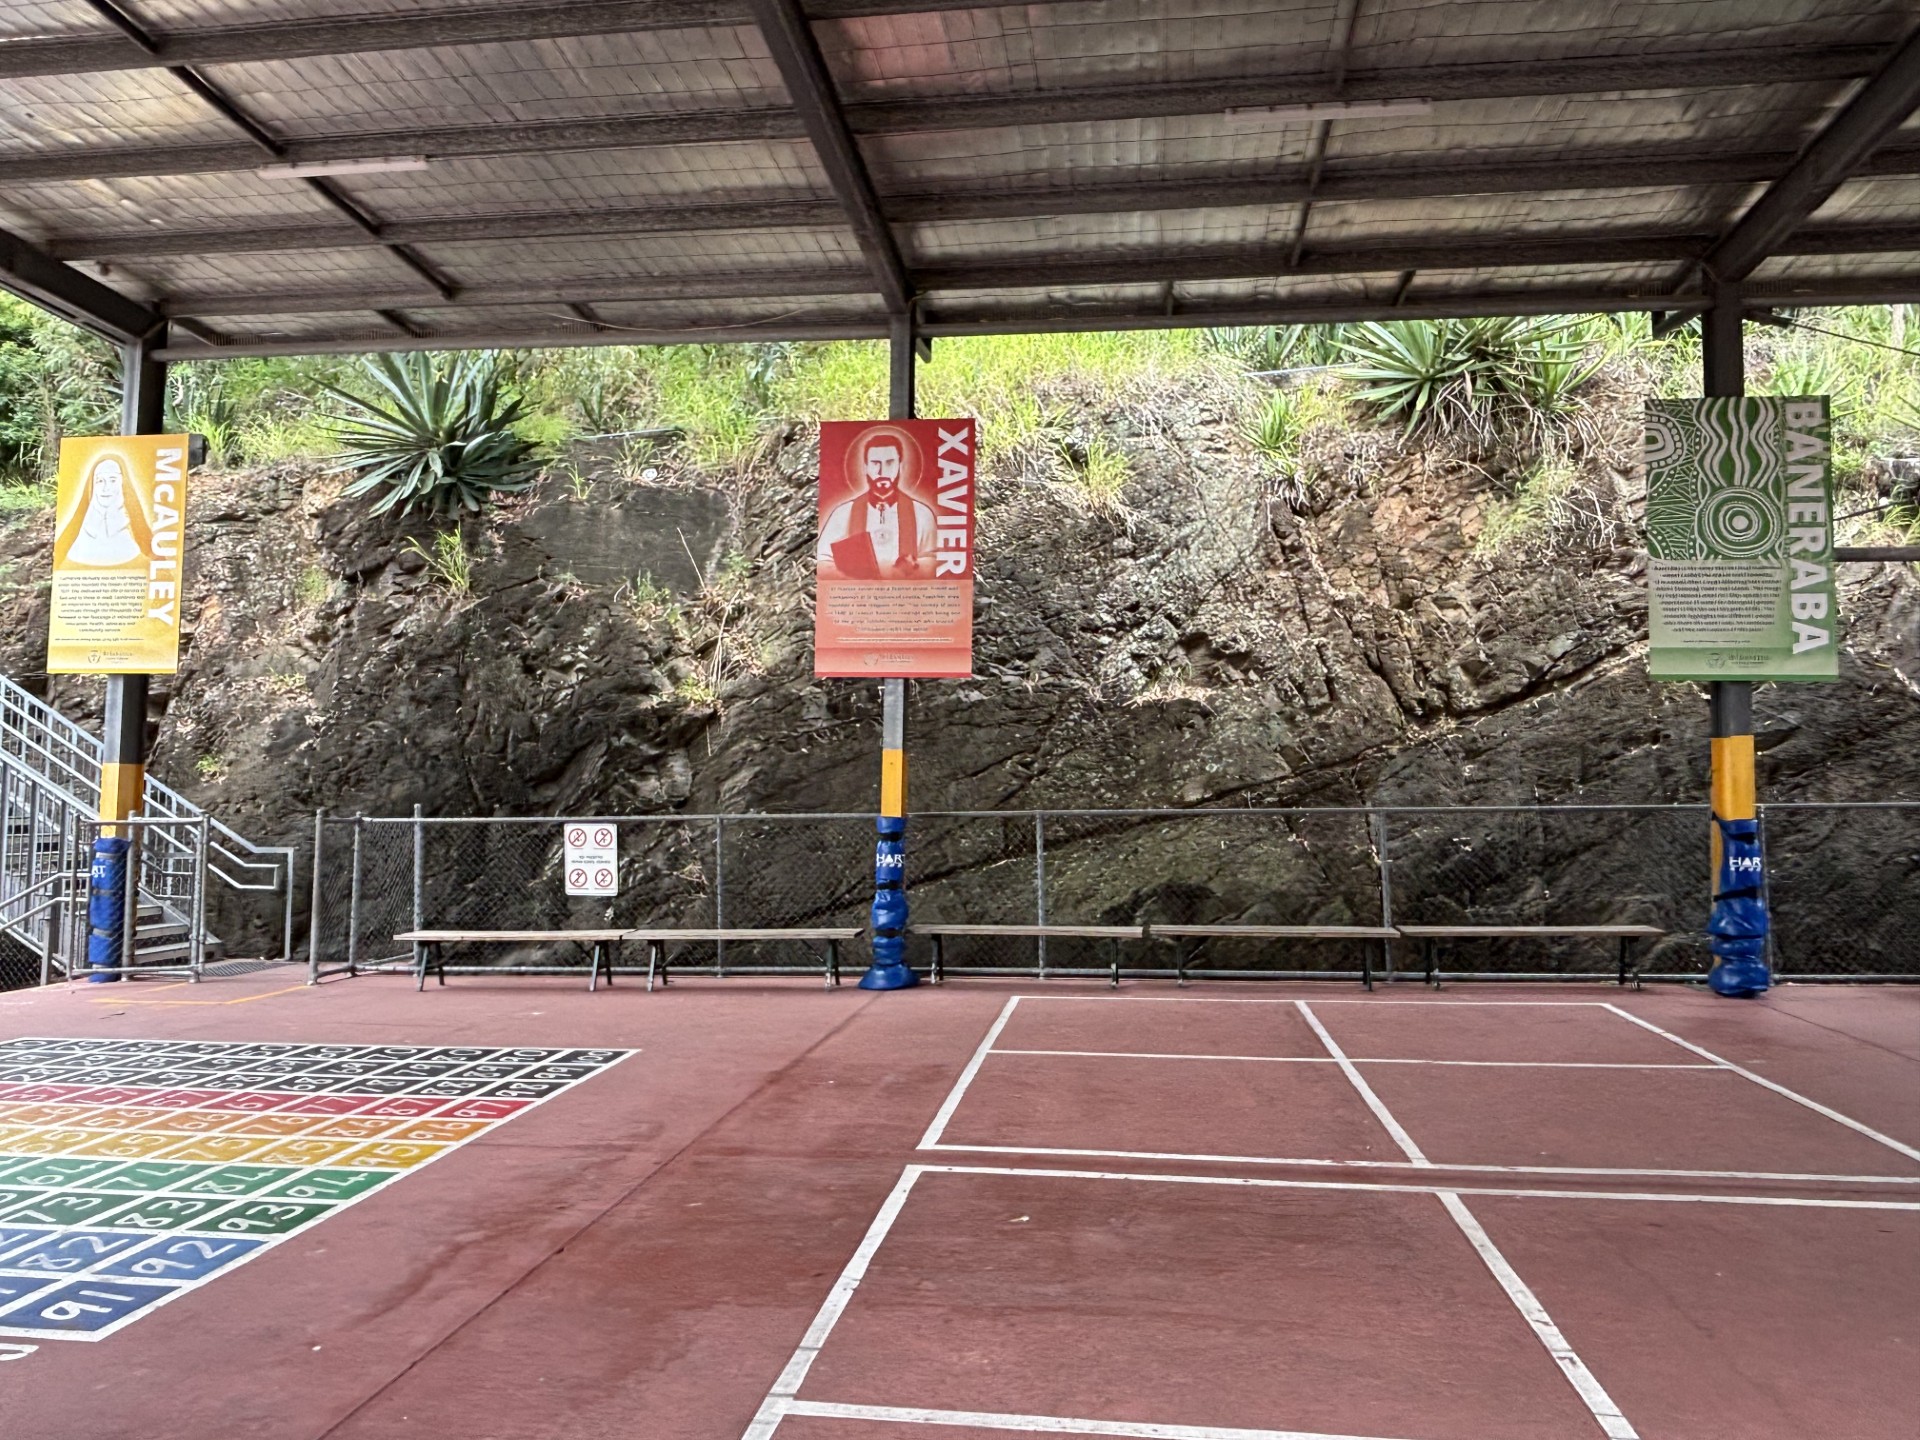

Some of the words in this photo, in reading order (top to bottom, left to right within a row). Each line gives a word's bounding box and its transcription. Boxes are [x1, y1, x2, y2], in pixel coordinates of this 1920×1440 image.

[935, 426, 969, 578] XAVIER
[1783, 400, 1830, 655] BANERABA
[360, 1047, 417, 1060] 70
[500, 1049, 548, 1061] 90
[571, 1050, 612, 1063] 100
[394, 1063, 446, 1076] 79
[463, 1064, 514, 1077] 89
[534, 1066, 584, 1079] 99
[279, 1077, 334, 1091] 68
[343, 1079, 405, 1093] 78
[420, 1081, 476, 1095] 88
[496, 1082, 549, 1097] 98
[147, 1091, 208, 1107] 57
[225, 1094, 279, 1109] 67
[294, 1096, 358, 1112] 77
[375, 1098, 433, 1115] 87
[454, 1100, 510, 1117] 97
[83, 1110, 155, 1127] 56
[168, 1112, 231, 1130] 66
[236, 1116, 311, 1133] 76
[322, 1119, 389, 1137] 86
[408, 1121, 471, 1140] 96
[8, 1130, 88, 1153] 55
[98, 1134, 167, 1156] 65
[167, 1136, 251, 1160] 75
[262, 1140, 334, 1164] 85
[349, 1144, 420, 1166] 95
[16, 1161, 102, 1185] 64
[92, 1164, 191, 1188] 74
[191, 1168, 278, 1193] 84
[286, 1172, 369, 1197] 94
[0, 1196, 102, 1222] 73
[114, 1200, 206, 1227] 83
[218, 1204, 305, 1231] 93
[17, 1235, 130, 1269] 82
[131, 1240, 237, 1274] 92
[40, 1289, 135, 1320] 91
